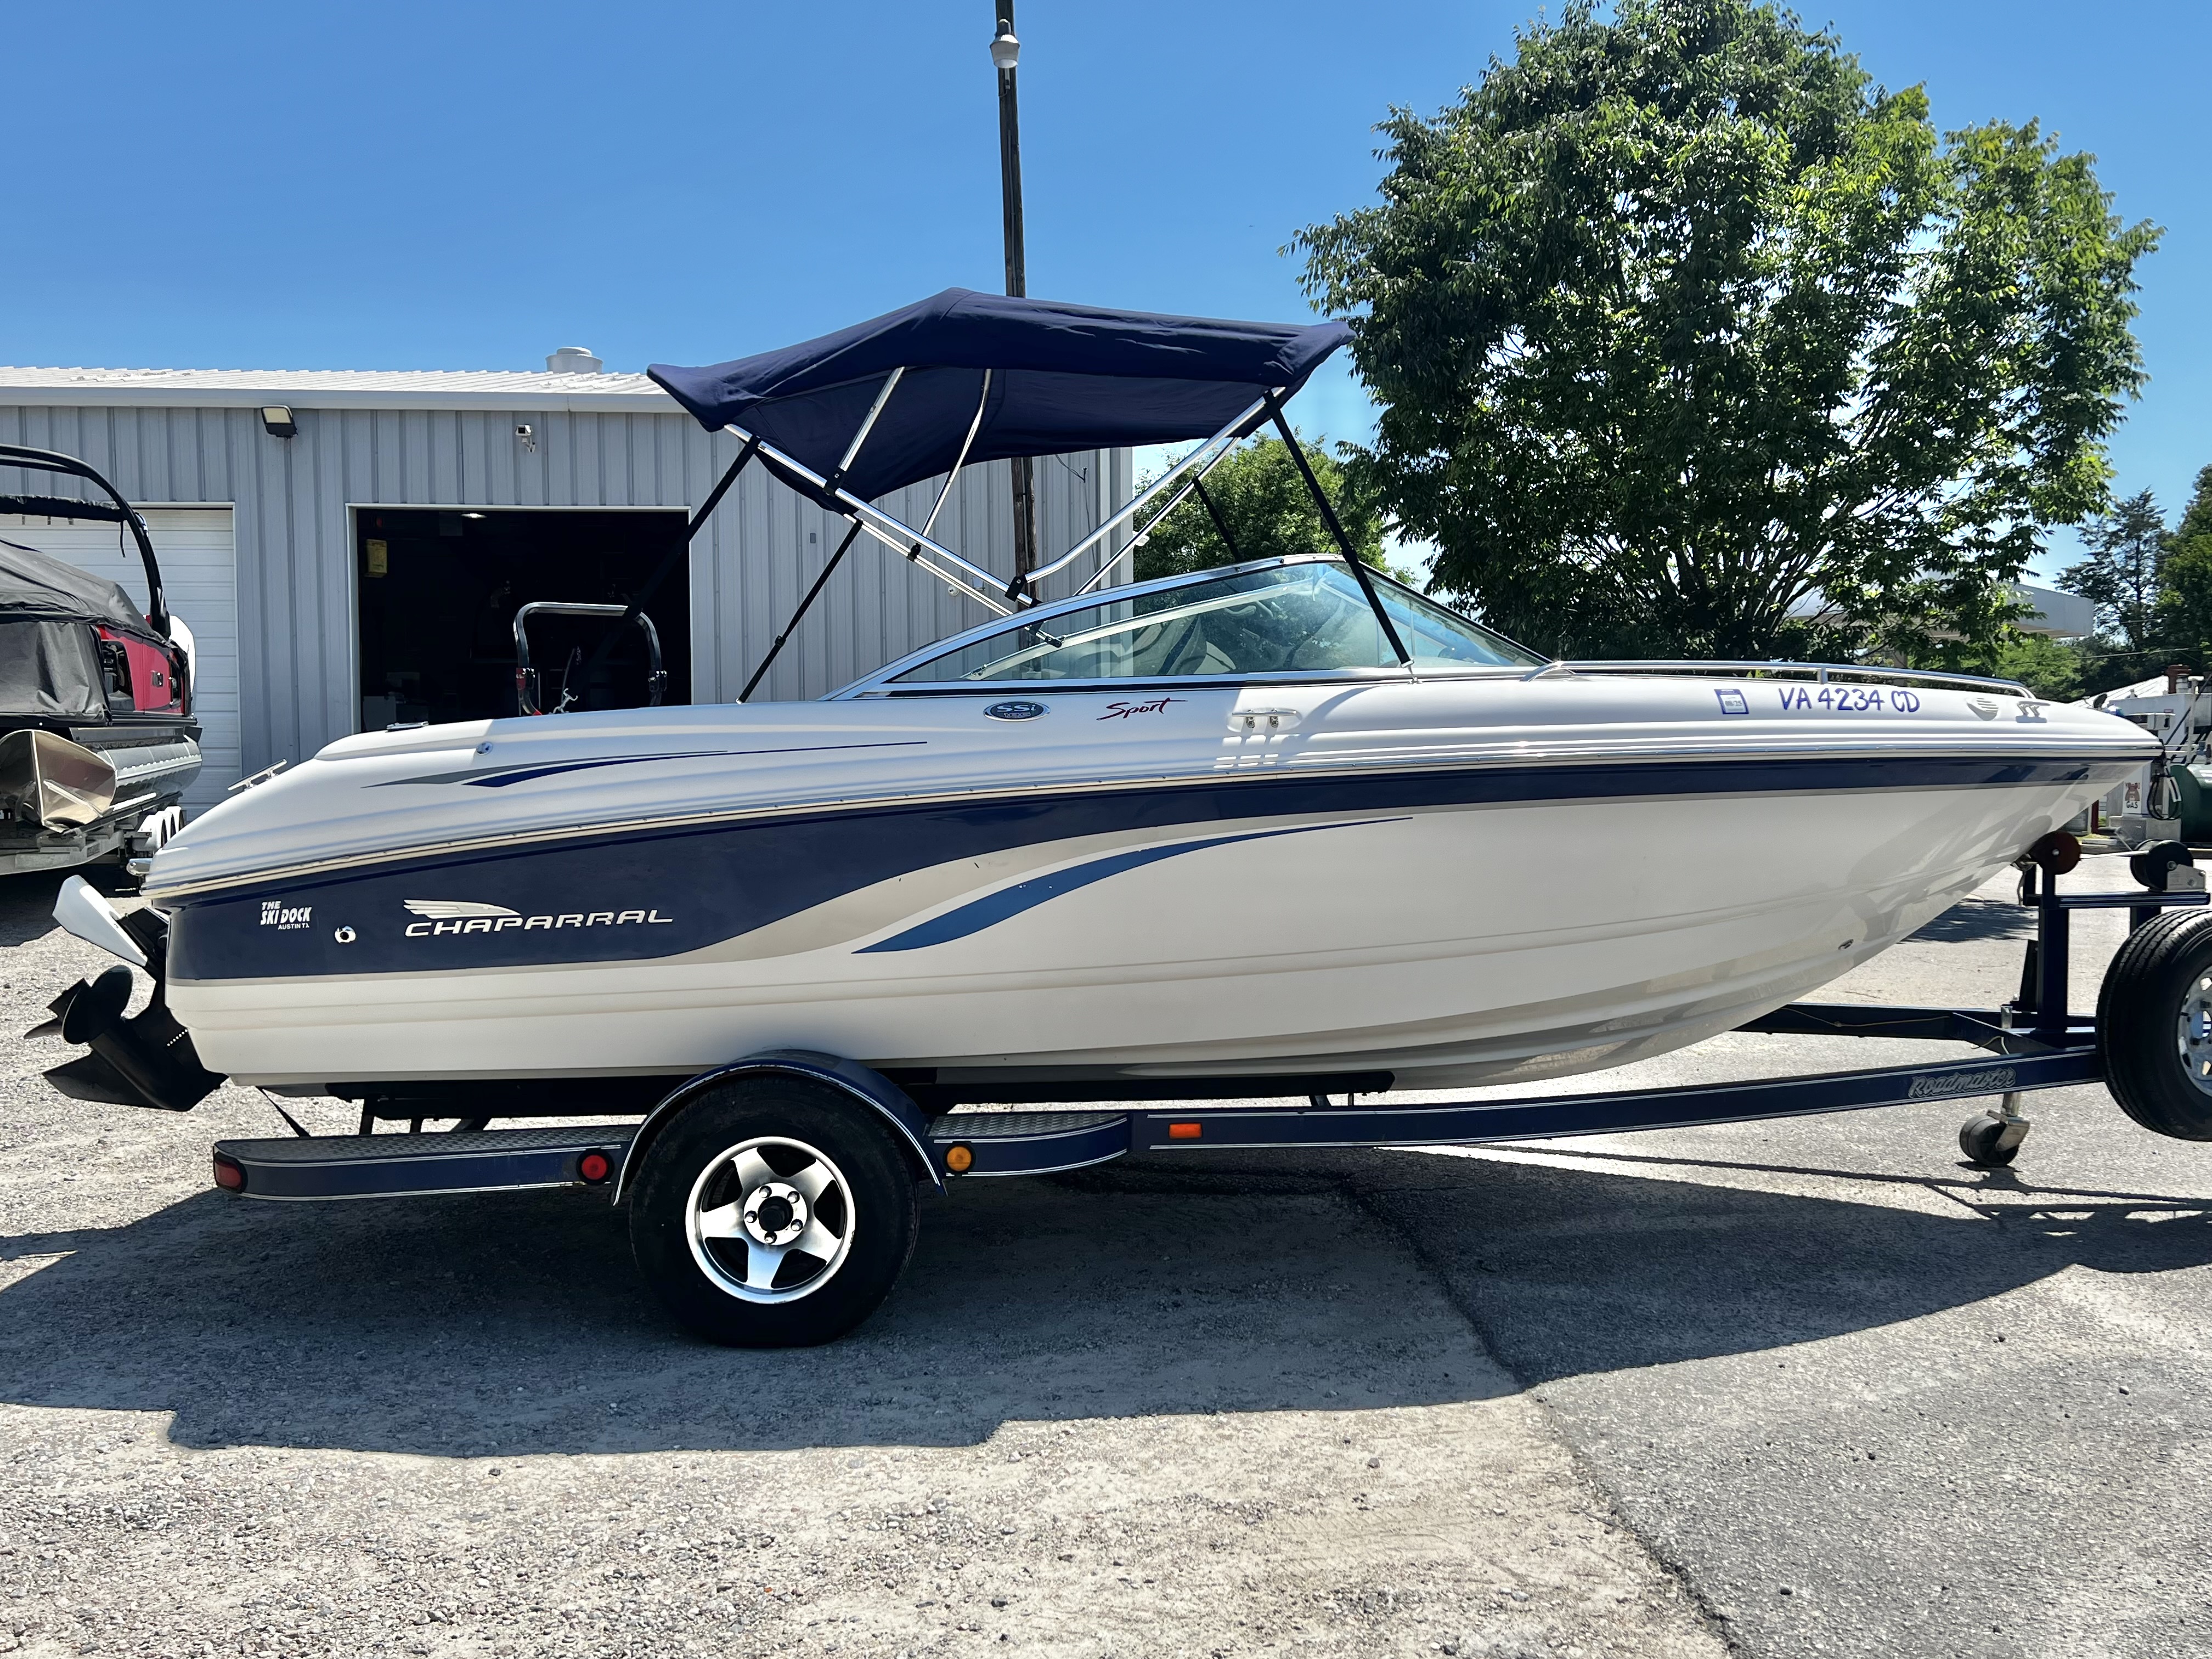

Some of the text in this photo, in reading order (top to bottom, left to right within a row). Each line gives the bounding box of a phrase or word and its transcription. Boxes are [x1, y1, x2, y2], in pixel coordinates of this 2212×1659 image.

[1096, 697, 1188, 720] Sport
[1778, 687, 1920, 713] VA 4234 CD
[260, 907, 312, 925] SKI DOCK
[262, 900, 281, 910] THE
[405, 909, 674, 937] CHAPARRAL
[1908, 1067, 2016, 1098] Roadmaster
